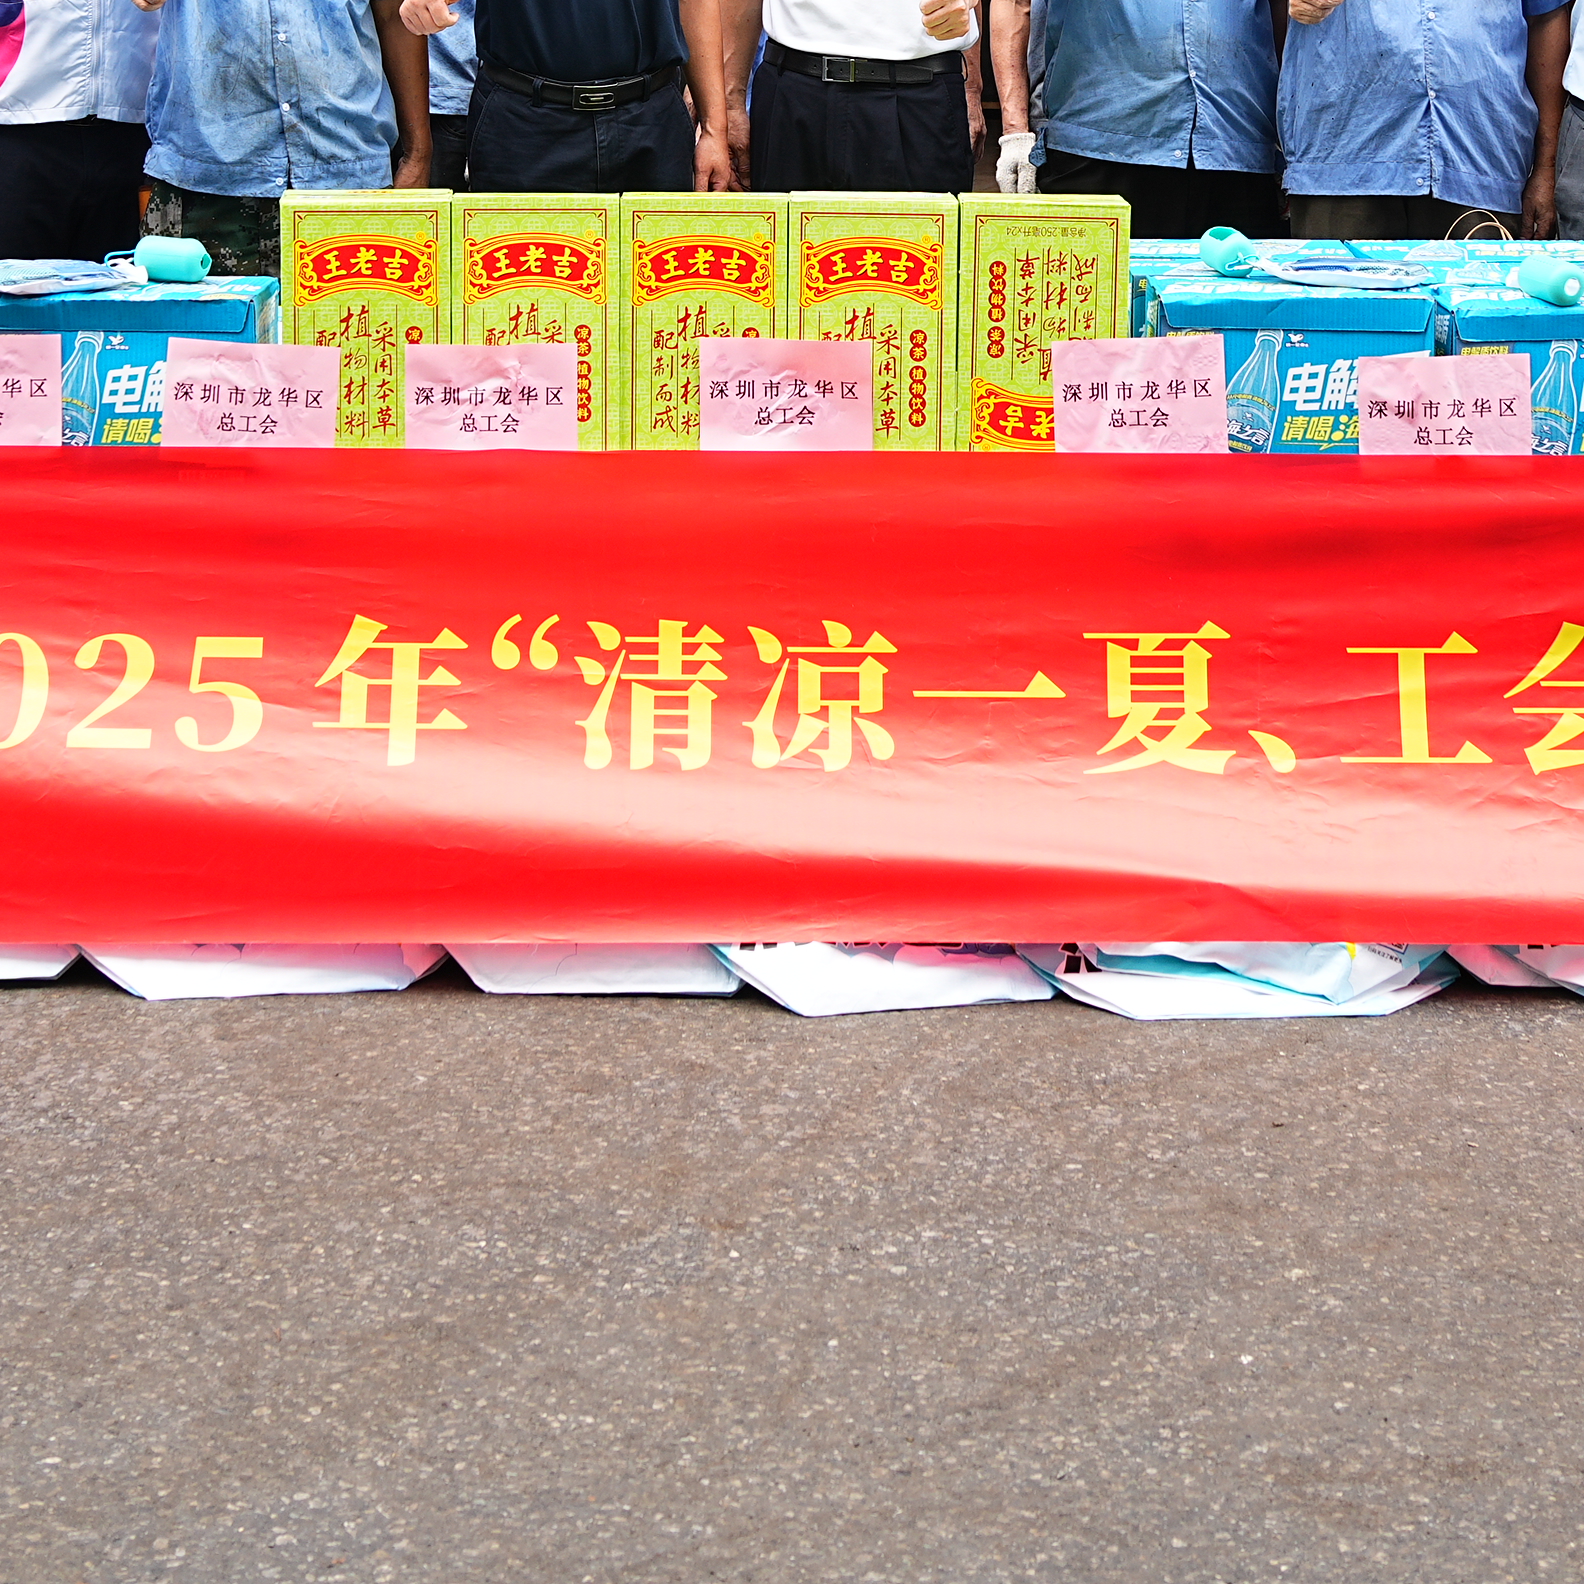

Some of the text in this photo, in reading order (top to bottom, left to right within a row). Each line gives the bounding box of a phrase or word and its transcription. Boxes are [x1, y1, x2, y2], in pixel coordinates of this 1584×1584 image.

[322, 246, 409, 281] 王老吉
[491, 245, 578, 279] 王老吉
[660, 247, 747, 282] 王老吉
[829, 249, 915, 284] 王老吉
[989, 262, 1007, 321] 植物饮料
[1014, 249, 1040, 365] 采用本草
[1069, 253, 1098, 342] 制而成
[911, 331, 926, 361] 凉茶
[989, 328, 1005, 357] 凉茶
[340, 304, 373, 441] 植物材料
[371, 321, 397, 436] 采用本草
[652, 329, 678, 434] 配制而成
[709, 378, 859, 400] 深圳市龙华区
[875, 324, 901, 439] 采用本草
[173, 382, 324, 410] 深圳市龙华区
[414, 386, 564, 407] 深圳市龙华区
[911, 368, 925, 425] 植物饮料
[1062, 377, 1213, 403] 深圳市龙华区
[216, 414, 278, 435] 总工会
[459, 413, 520, 434] 总工会
[754, 405, 816, 427] 总工会
[999, 405, 1055, 439] 老吉
[1108, 407, 1170, 429] 总工会
[1367, 397, 1517, 420] 深圳市龙华区
[1413, 425, 1474, 447] 总工会
